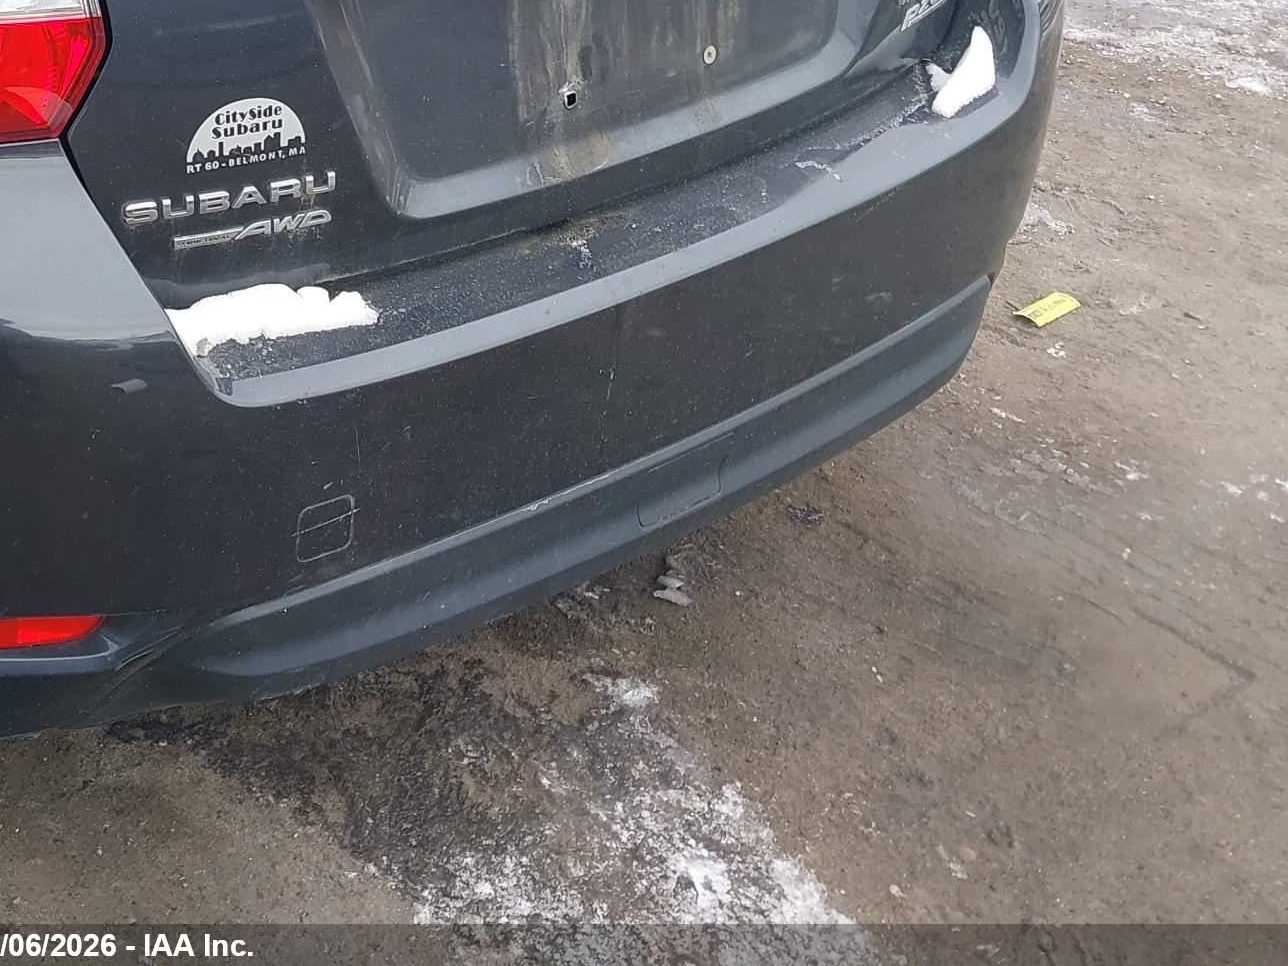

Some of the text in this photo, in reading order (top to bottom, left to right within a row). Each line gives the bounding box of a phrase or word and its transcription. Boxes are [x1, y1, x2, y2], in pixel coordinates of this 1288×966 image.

[211, 118, 283, 139] Subaru
[186, 163, 202, 174] RT
[288, 146, 306, 157] MA
[124, 171, 336, 225] SUBARU
[234, 209, 332, 240] AWD
